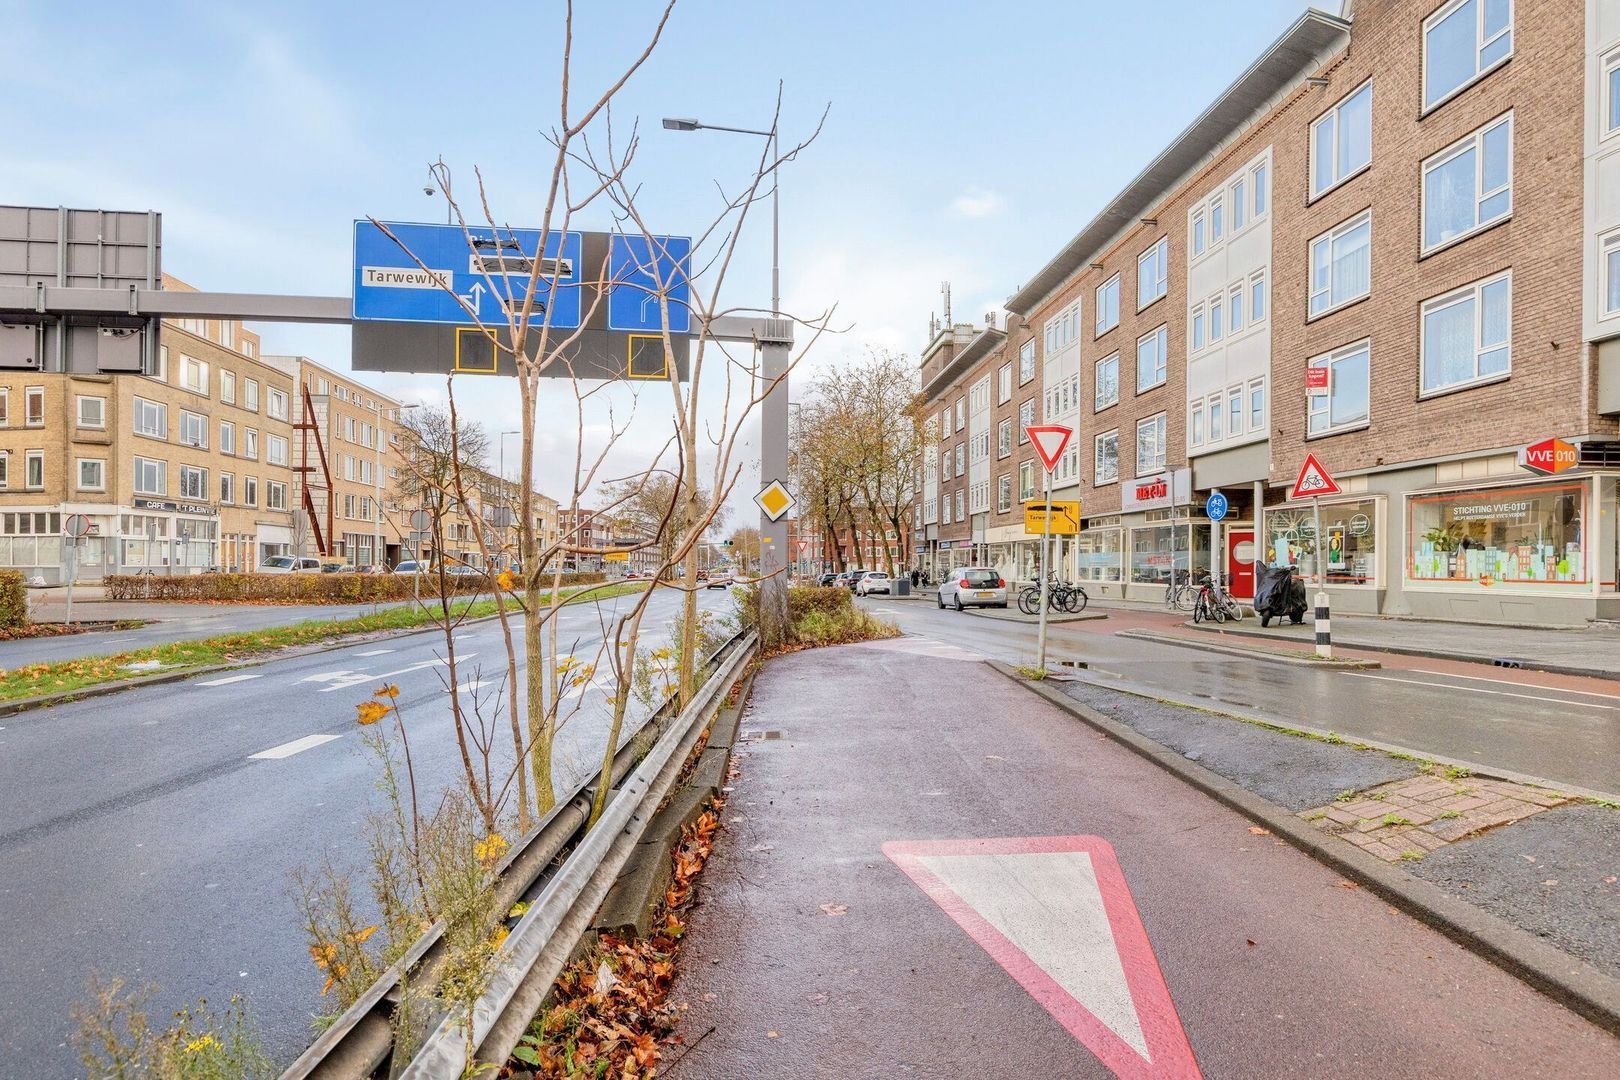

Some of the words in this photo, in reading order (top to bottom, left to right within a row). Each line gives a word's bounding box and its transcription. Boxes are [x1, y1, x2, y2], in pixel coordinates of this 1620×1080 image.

[367, 269, 447, 287] Tarwewijk
[1527, 450, 1554, 462] VVE
[1556, 450, 1576, 462] 010
[147, 501, 166, 510] CAFE
[1453, 505, 1492, 515] STICHTING
[1493, 503, 1526, 512] VVE-010
